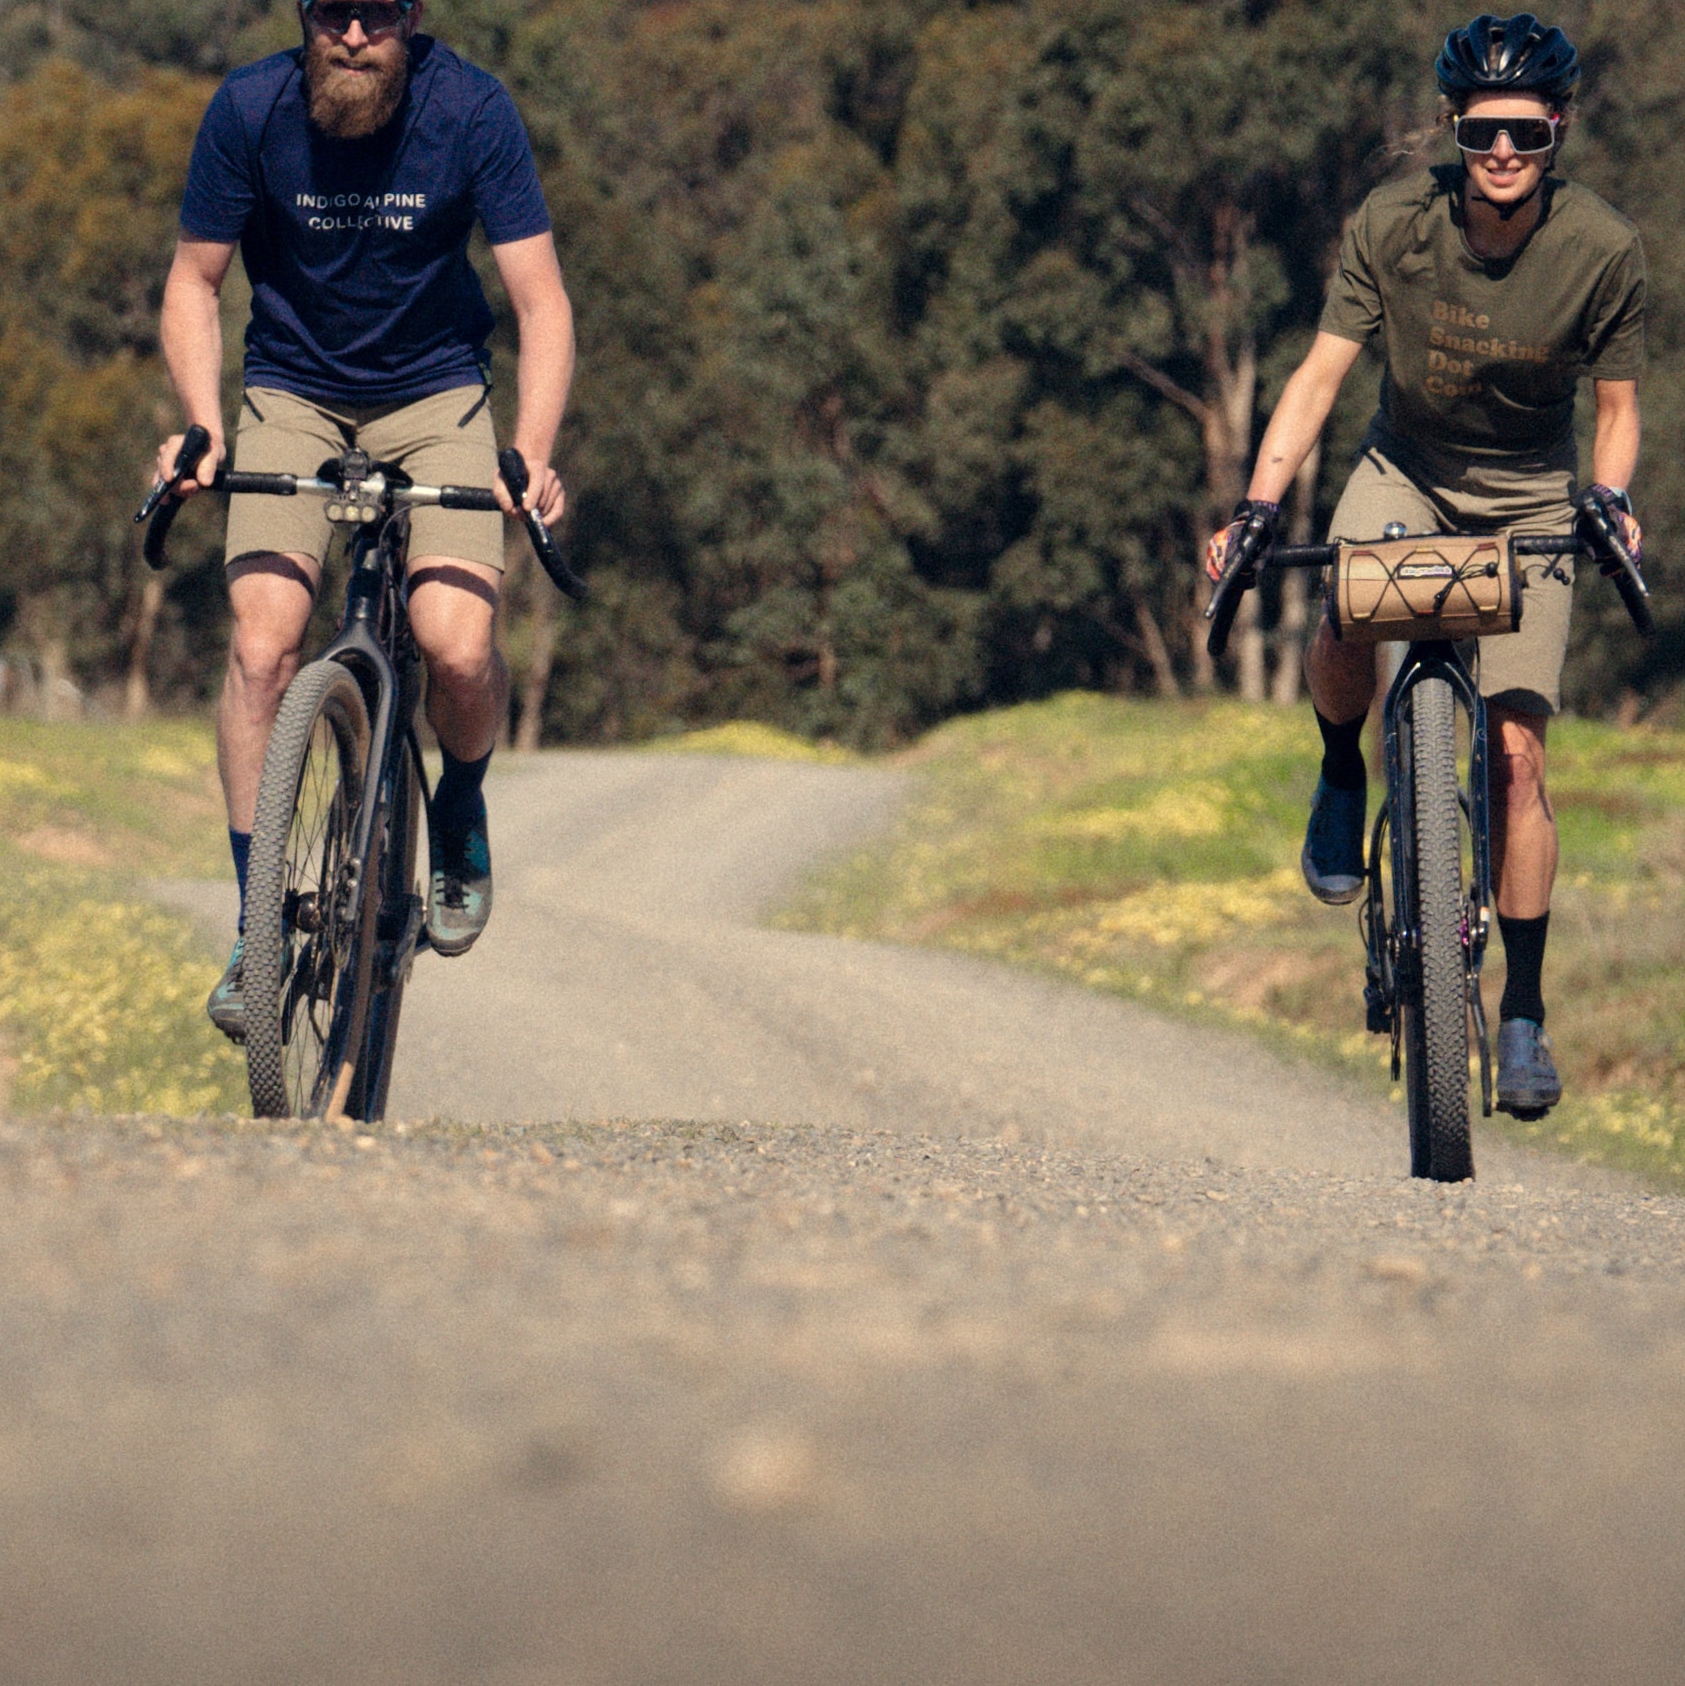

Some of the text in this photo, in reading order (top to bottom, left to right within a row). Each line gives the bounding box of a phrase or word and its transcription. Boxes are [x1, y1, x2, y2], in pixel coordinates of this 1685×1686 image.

[296, 193, 361, 209] INDIGO
[308, 215, 414, 231] COLLECTIVE
[1433, 299, 1490, 330] Bike
[1429, 325, 1550, 363] Snacking
[1428, 349, 1474, 377] Dot
